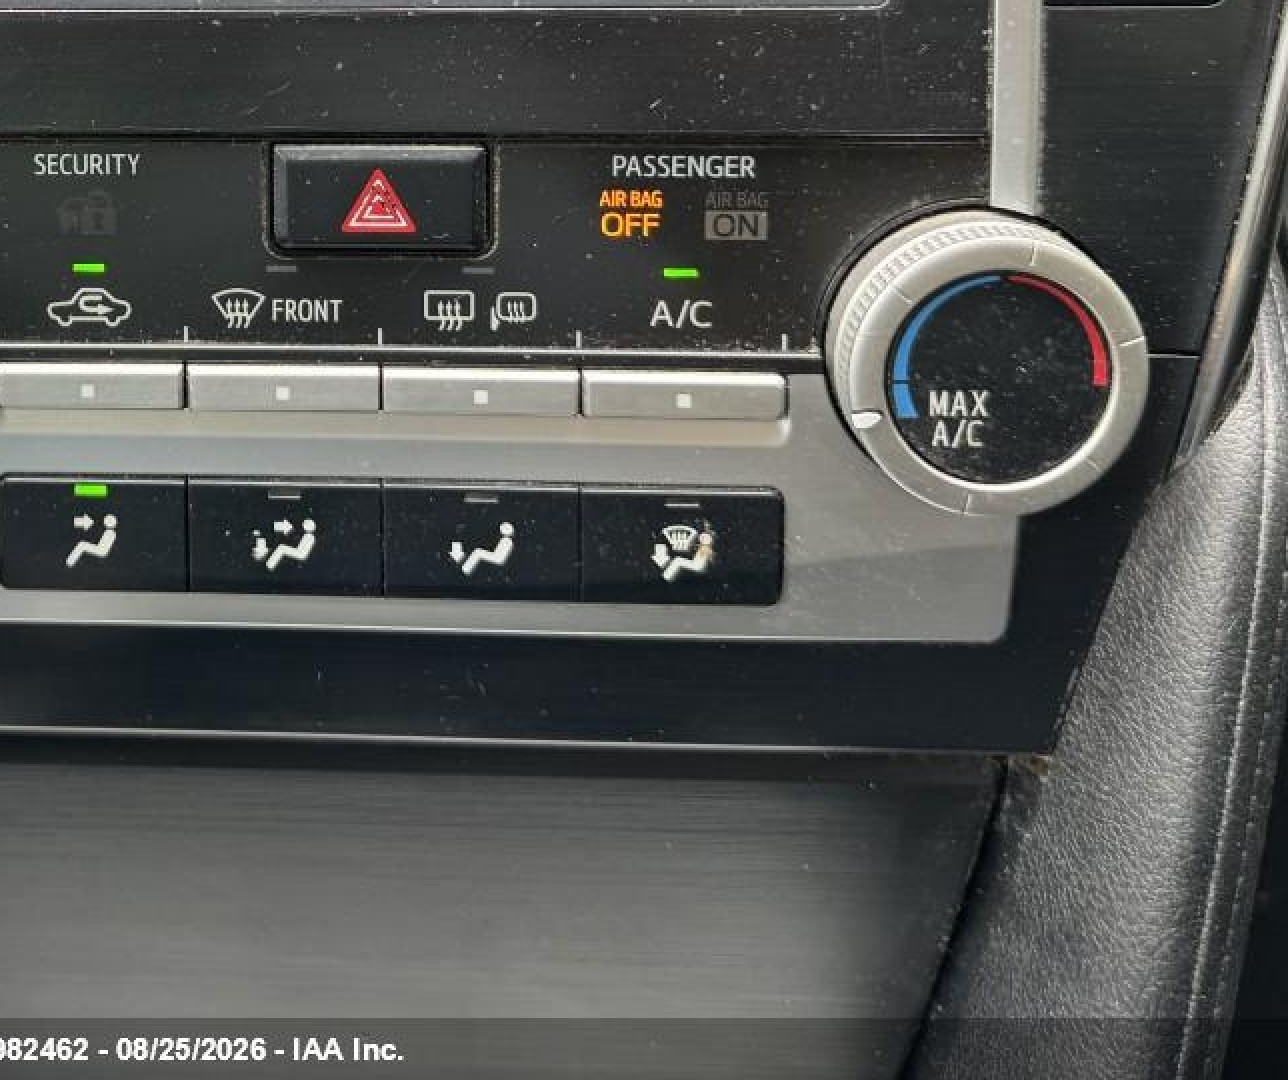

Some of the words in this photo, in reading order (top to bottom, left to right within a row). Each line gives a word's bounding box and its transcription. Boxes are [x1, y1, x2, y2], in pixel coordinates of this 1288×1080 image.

[33, 153, 141, 176] SECURITY
[611, 155, 757, 179] PASSENGER
[599, 190, 627, 208] AIR
[629, 190, 663, 208] BAG
[706, 191, 732, 209] AIR
[735, 191, 769, 209] BAG
[601, 213, 661, 238] OFF
[713, 213, 759, 239] ON
[271, 298, 344, 324] FRONT
[649, 299, 714, 329] A/C
[928, 390, 990, 418] MAX
[931, 420, 985, 450] A/C
